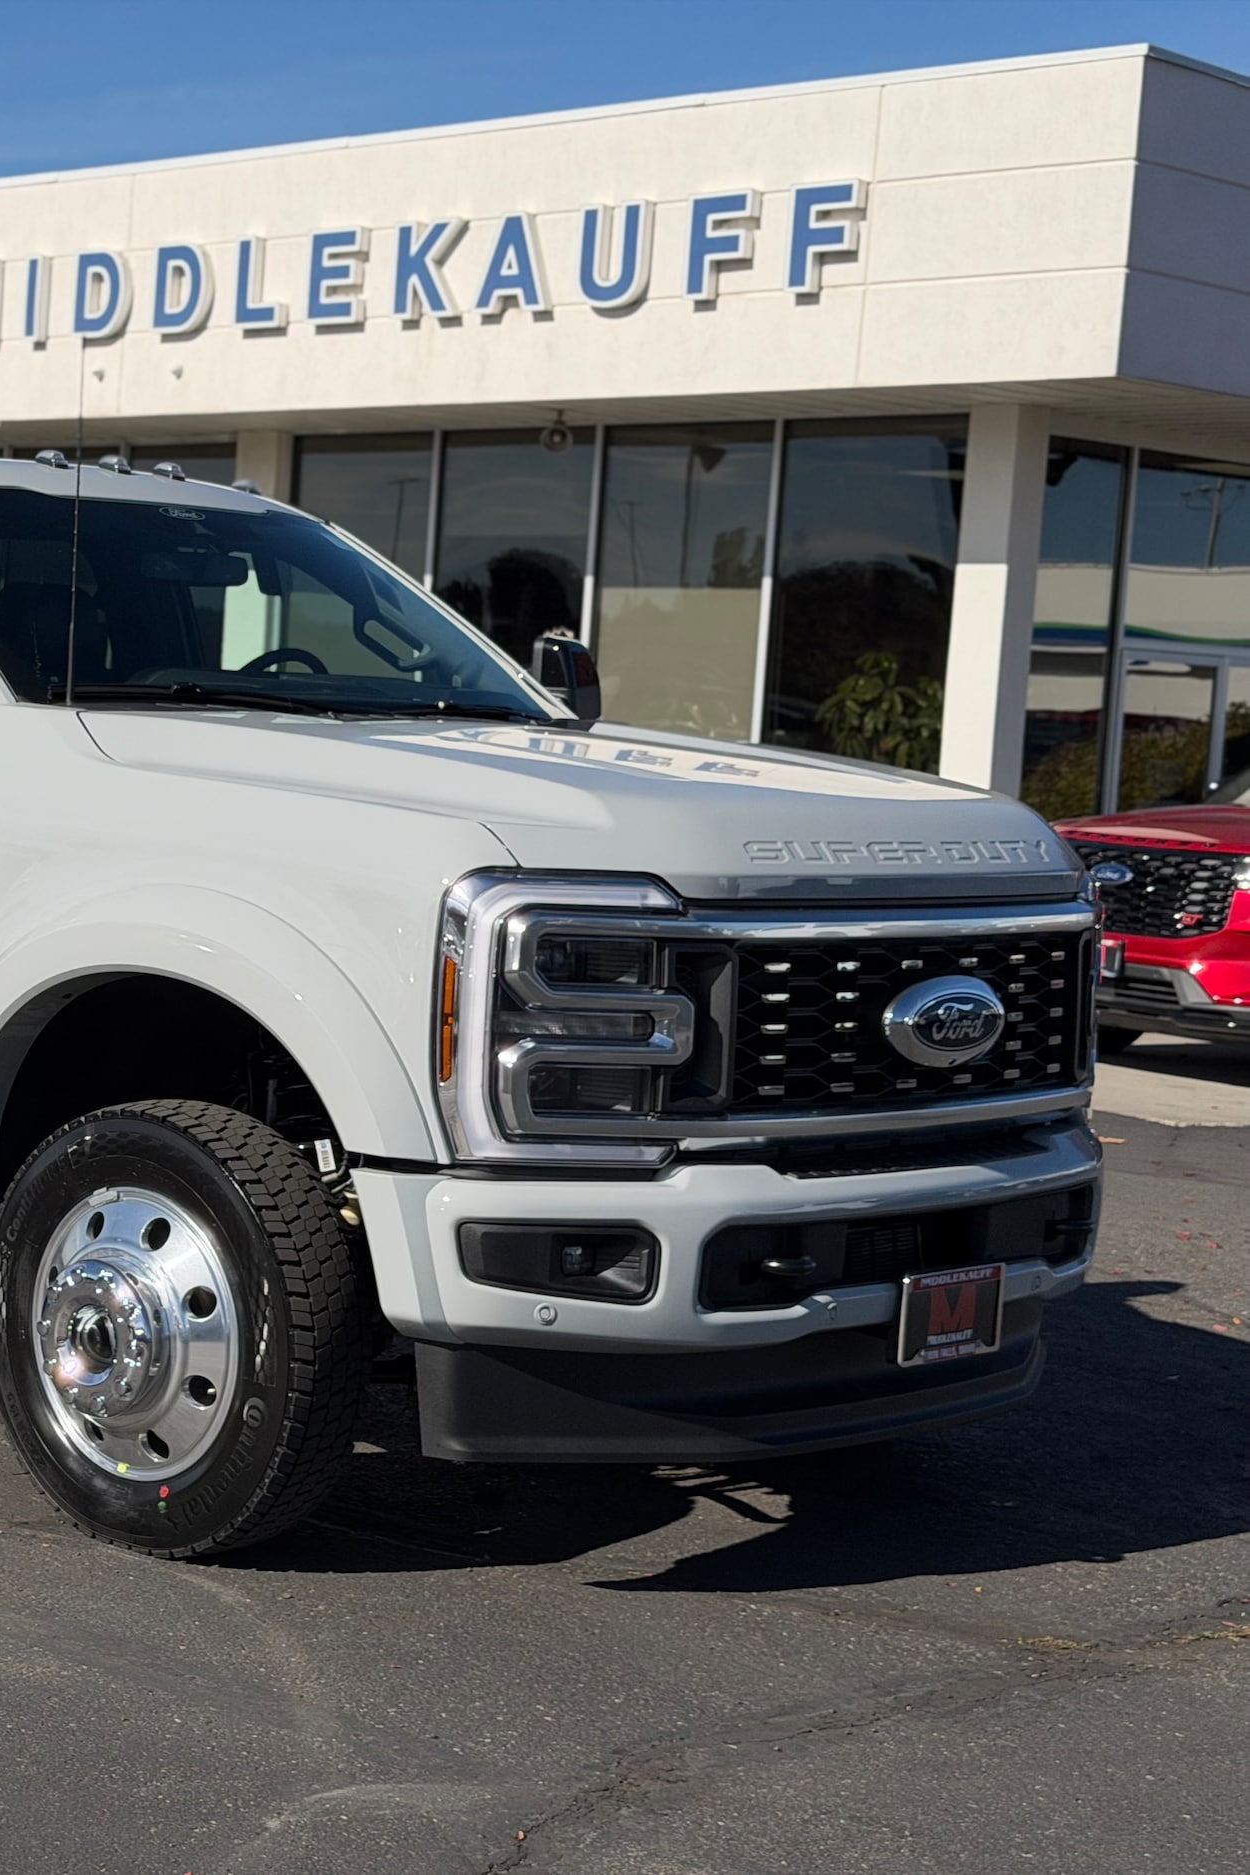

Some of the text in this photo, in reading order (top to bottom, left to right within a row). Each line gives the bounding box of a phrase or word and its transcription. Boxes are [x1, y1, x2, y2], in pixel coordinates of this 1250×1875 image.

[742, 838, 1050, 865] SUPER DUTY
[932, 1001, 984, 1041] Ford
[929, 1284, 977, 1334] M
